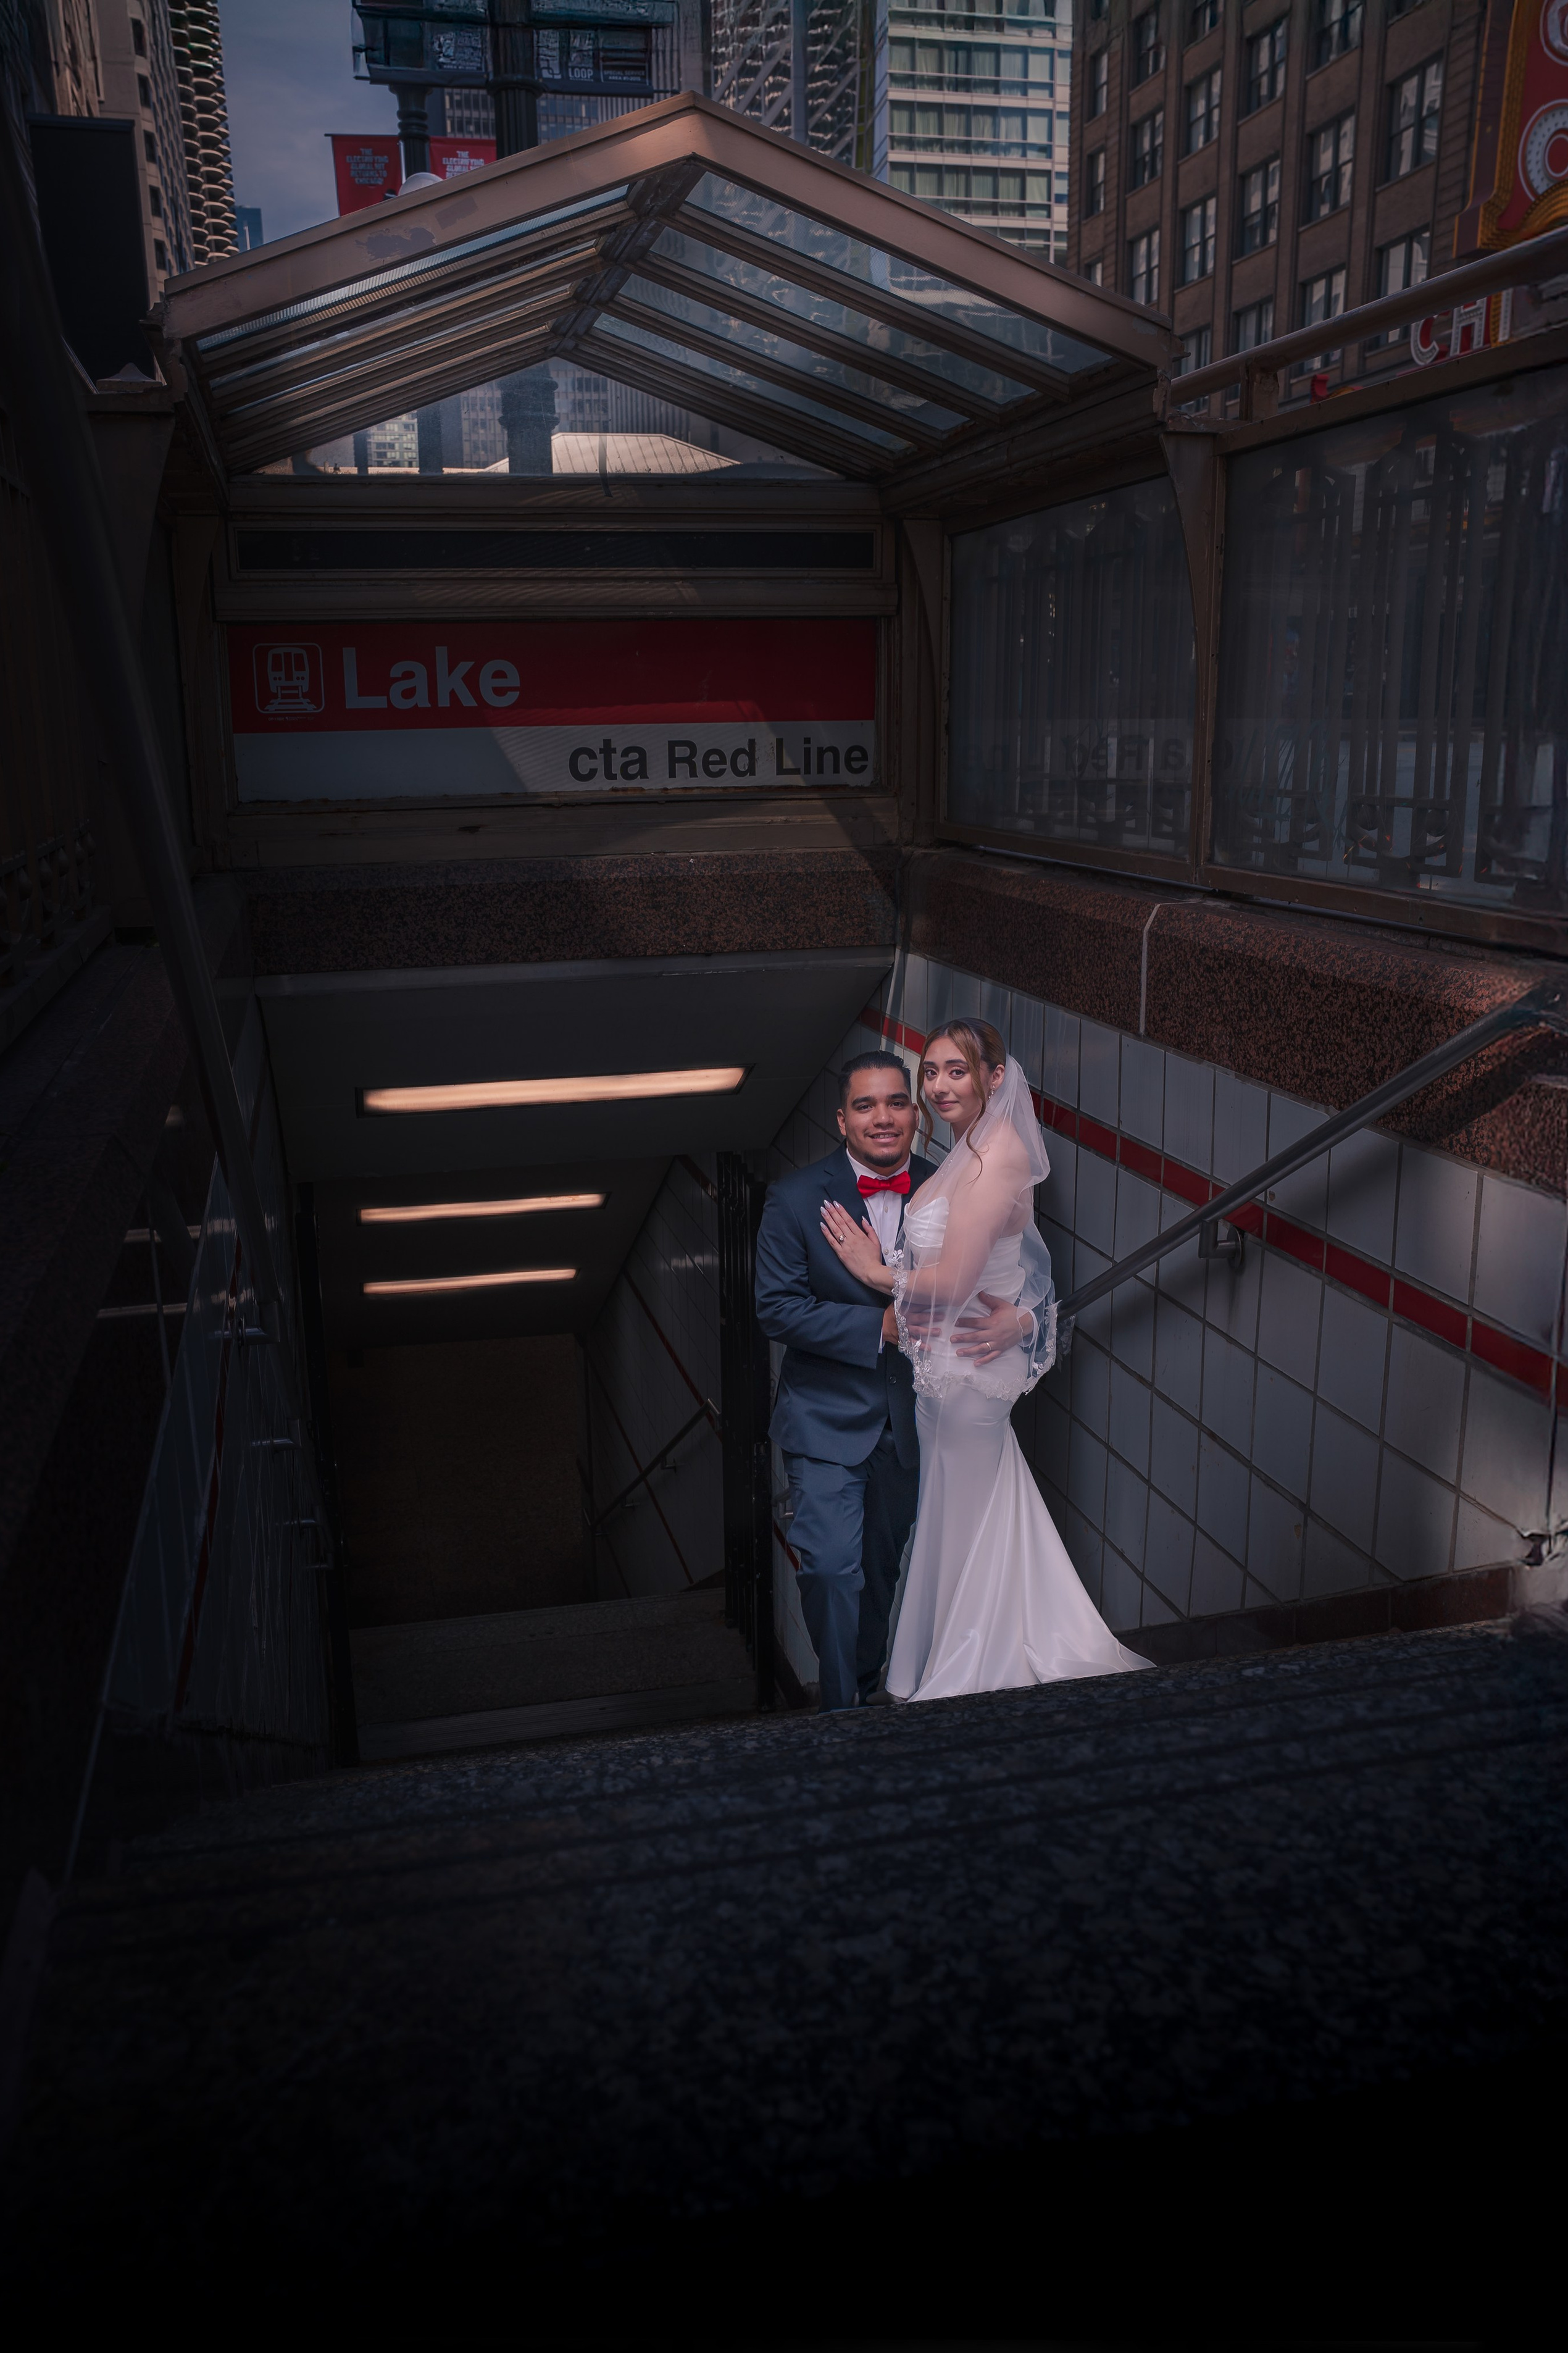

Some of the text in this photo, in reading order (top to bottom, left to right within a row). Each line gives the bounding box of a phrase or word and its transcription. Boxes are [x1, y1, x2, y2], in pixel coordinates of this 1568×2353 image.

[569, 67, 593, 78] LOOP
[343, 646, 520, 709] Lake
[569, 737, 869, 782] cta Red Line
